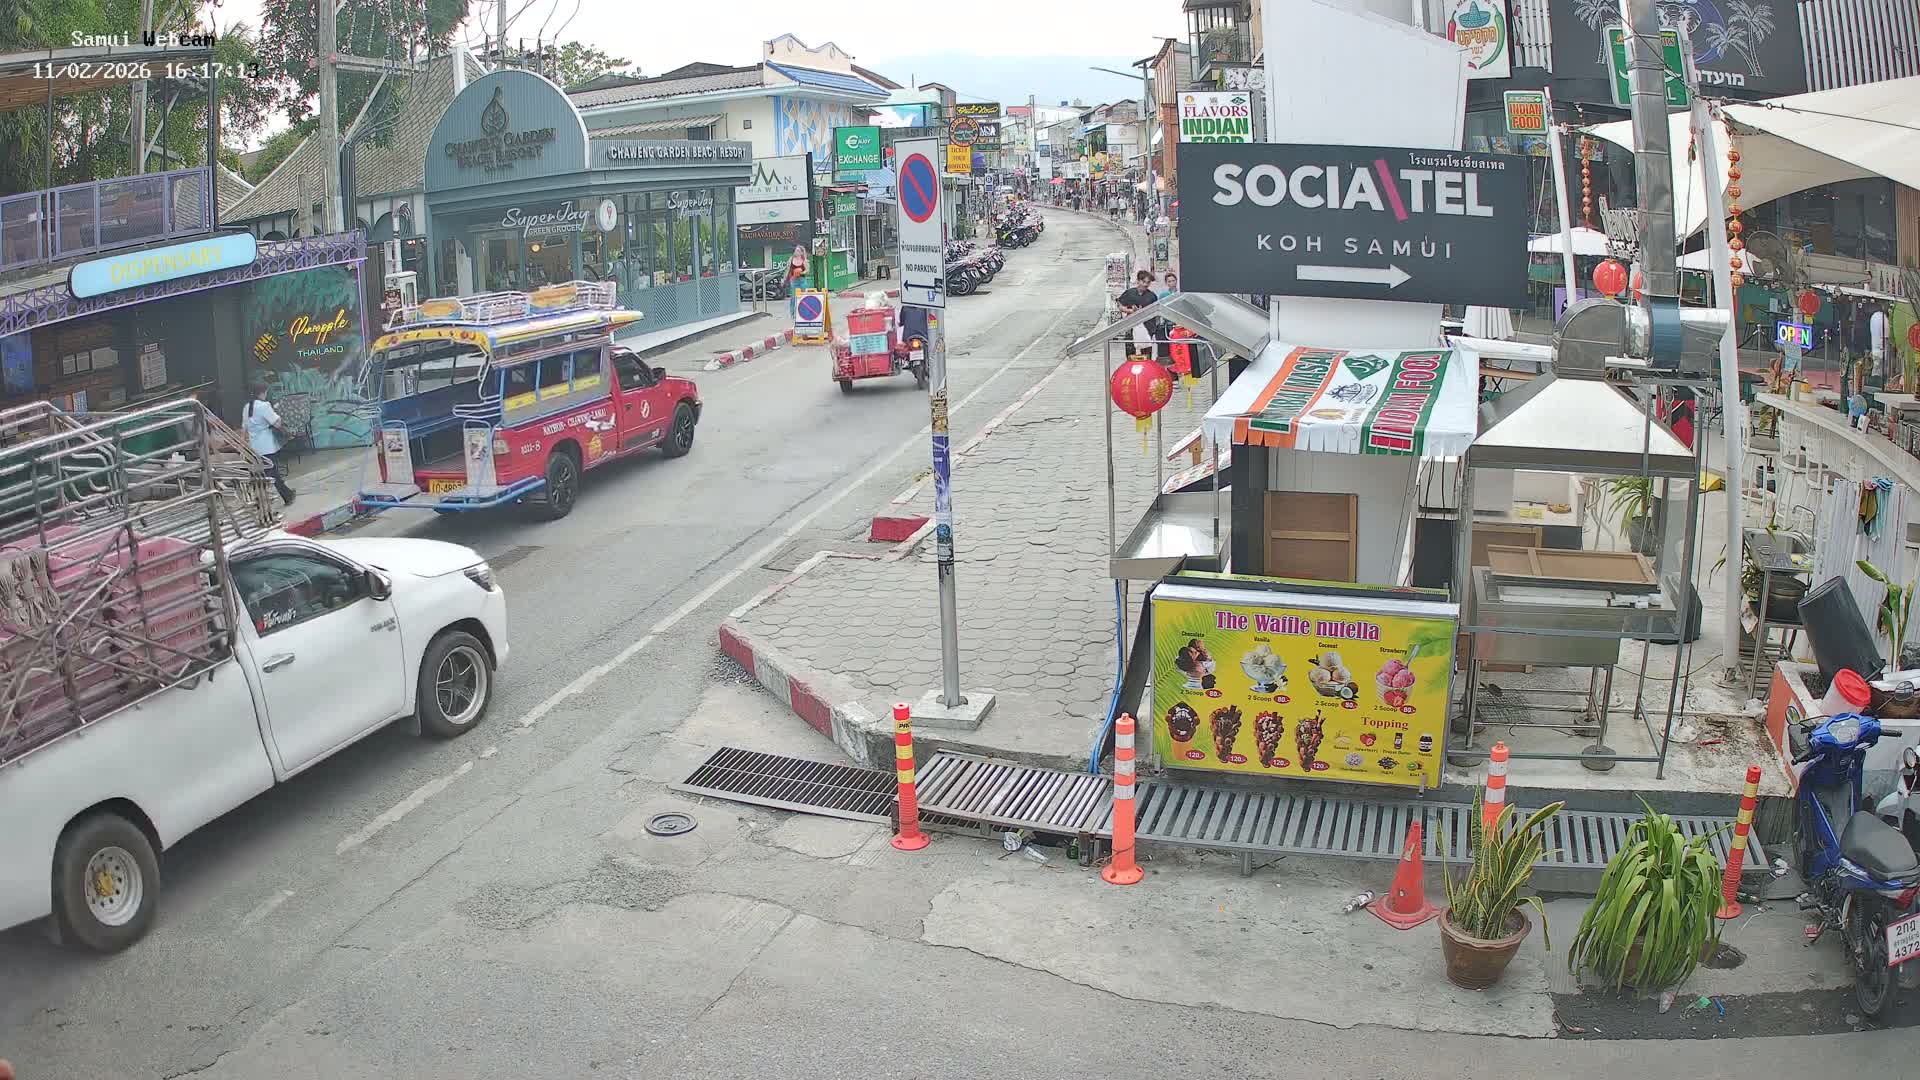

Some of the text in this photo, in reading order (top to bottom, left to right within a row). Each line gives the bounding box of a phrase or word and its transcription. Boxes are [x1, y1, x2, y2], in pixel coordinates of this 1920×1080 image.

[1184, 106, 1249, 117] FLAVORS
[1508, 103, 1542, 115] INDIAN
[1182, 118, 1249, 135] INDIAN
[1512, 116, 1542, 129] FOOD
[611, 146, 747, 159] CHAWENG GARDEN BEACH RESORT
[838, 154, 879, 164] EXCHANGE
[528, 223, 582, 235] GREEN GROCER
[1257, 234, 1451, 259] KOH SAMUI
[111, 245, 224, 284] DISPENSARY
[905, 263, 938, 273] NO PARKING
[1779, 325, 1810, 345] OPEN
[297, 345, 345, 358] THAILAND
[1368, 392, 1430, 452] INDIAN
[1215, 610, 1381, 642] The Waffle nutella
[1181, 630, 1205, 638] Chocolate
[1318, 641, 1339, 649] Coconut
[1379, 646, 1408, 655] Strawberry
[1186, 689, 1204, 697] Scoop
[1361, 716, 1409, 731] Topping
[1895, 940, 1920, 959] 4372
